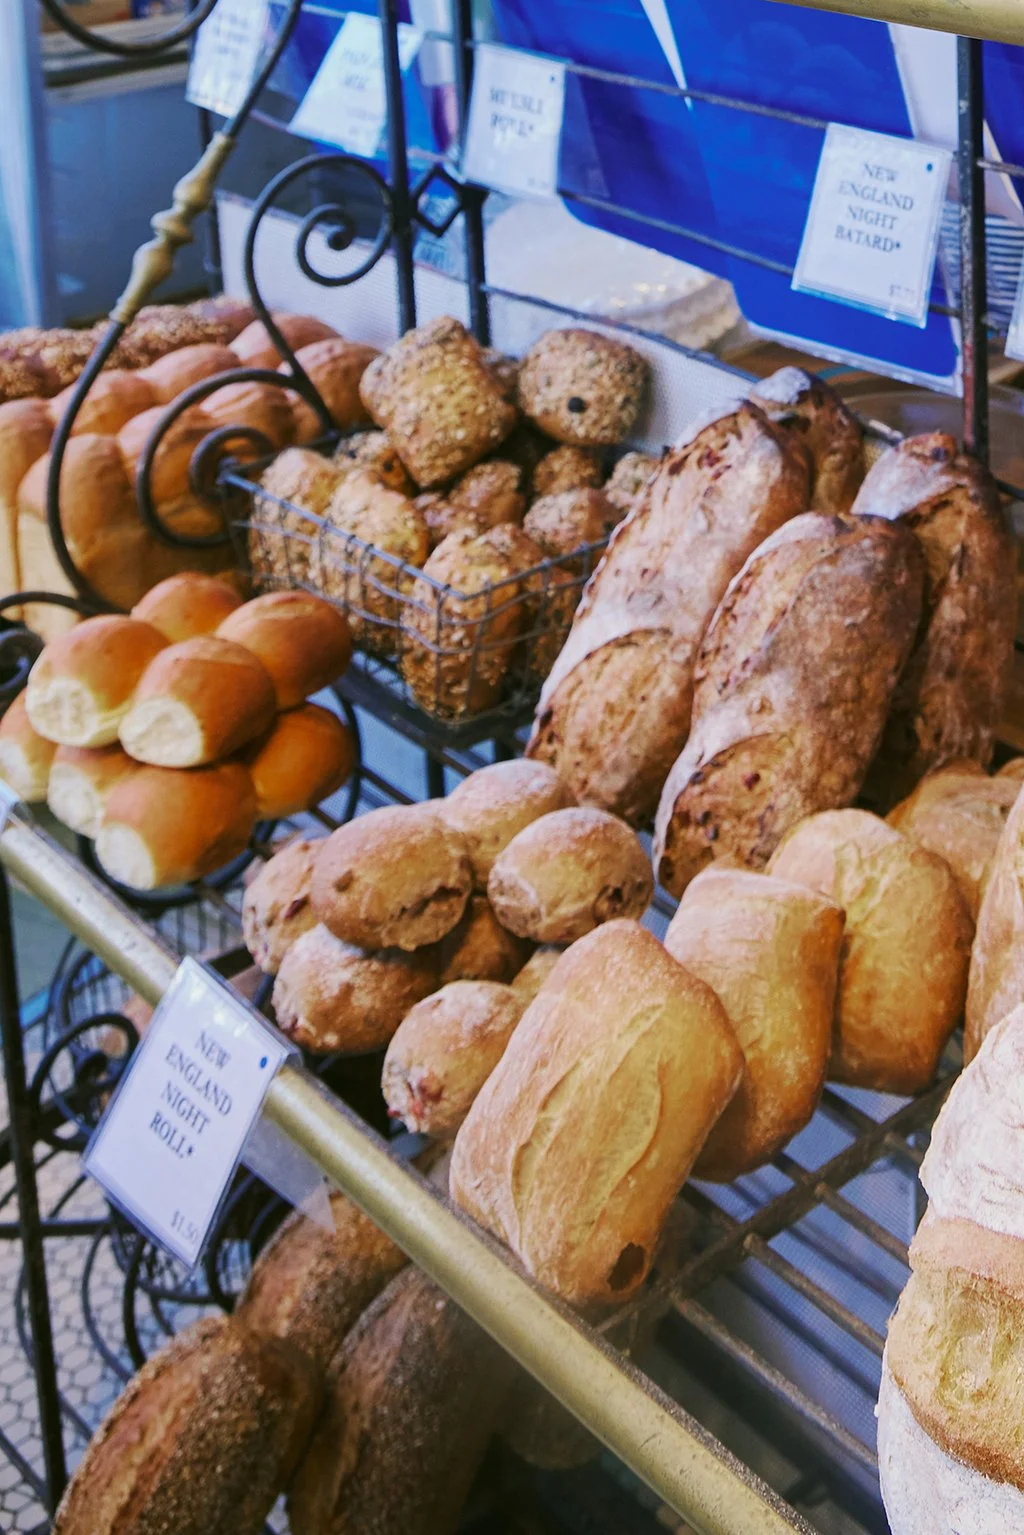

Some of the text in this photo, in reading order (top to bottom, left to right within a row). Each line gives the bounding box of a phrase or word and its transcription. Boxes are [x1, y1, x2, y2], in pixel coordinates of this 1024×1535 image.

[863, 163, 899, 183] NEW
[838, 180, 914, 211] ENGLAND
[847, 204, 899, 231] NIGHT
[194, 1030, 231, 1072] NEW
[165, 1043, 233, 1116] ENGLAND
[160, 1079, 212, 1134] NIGHT
